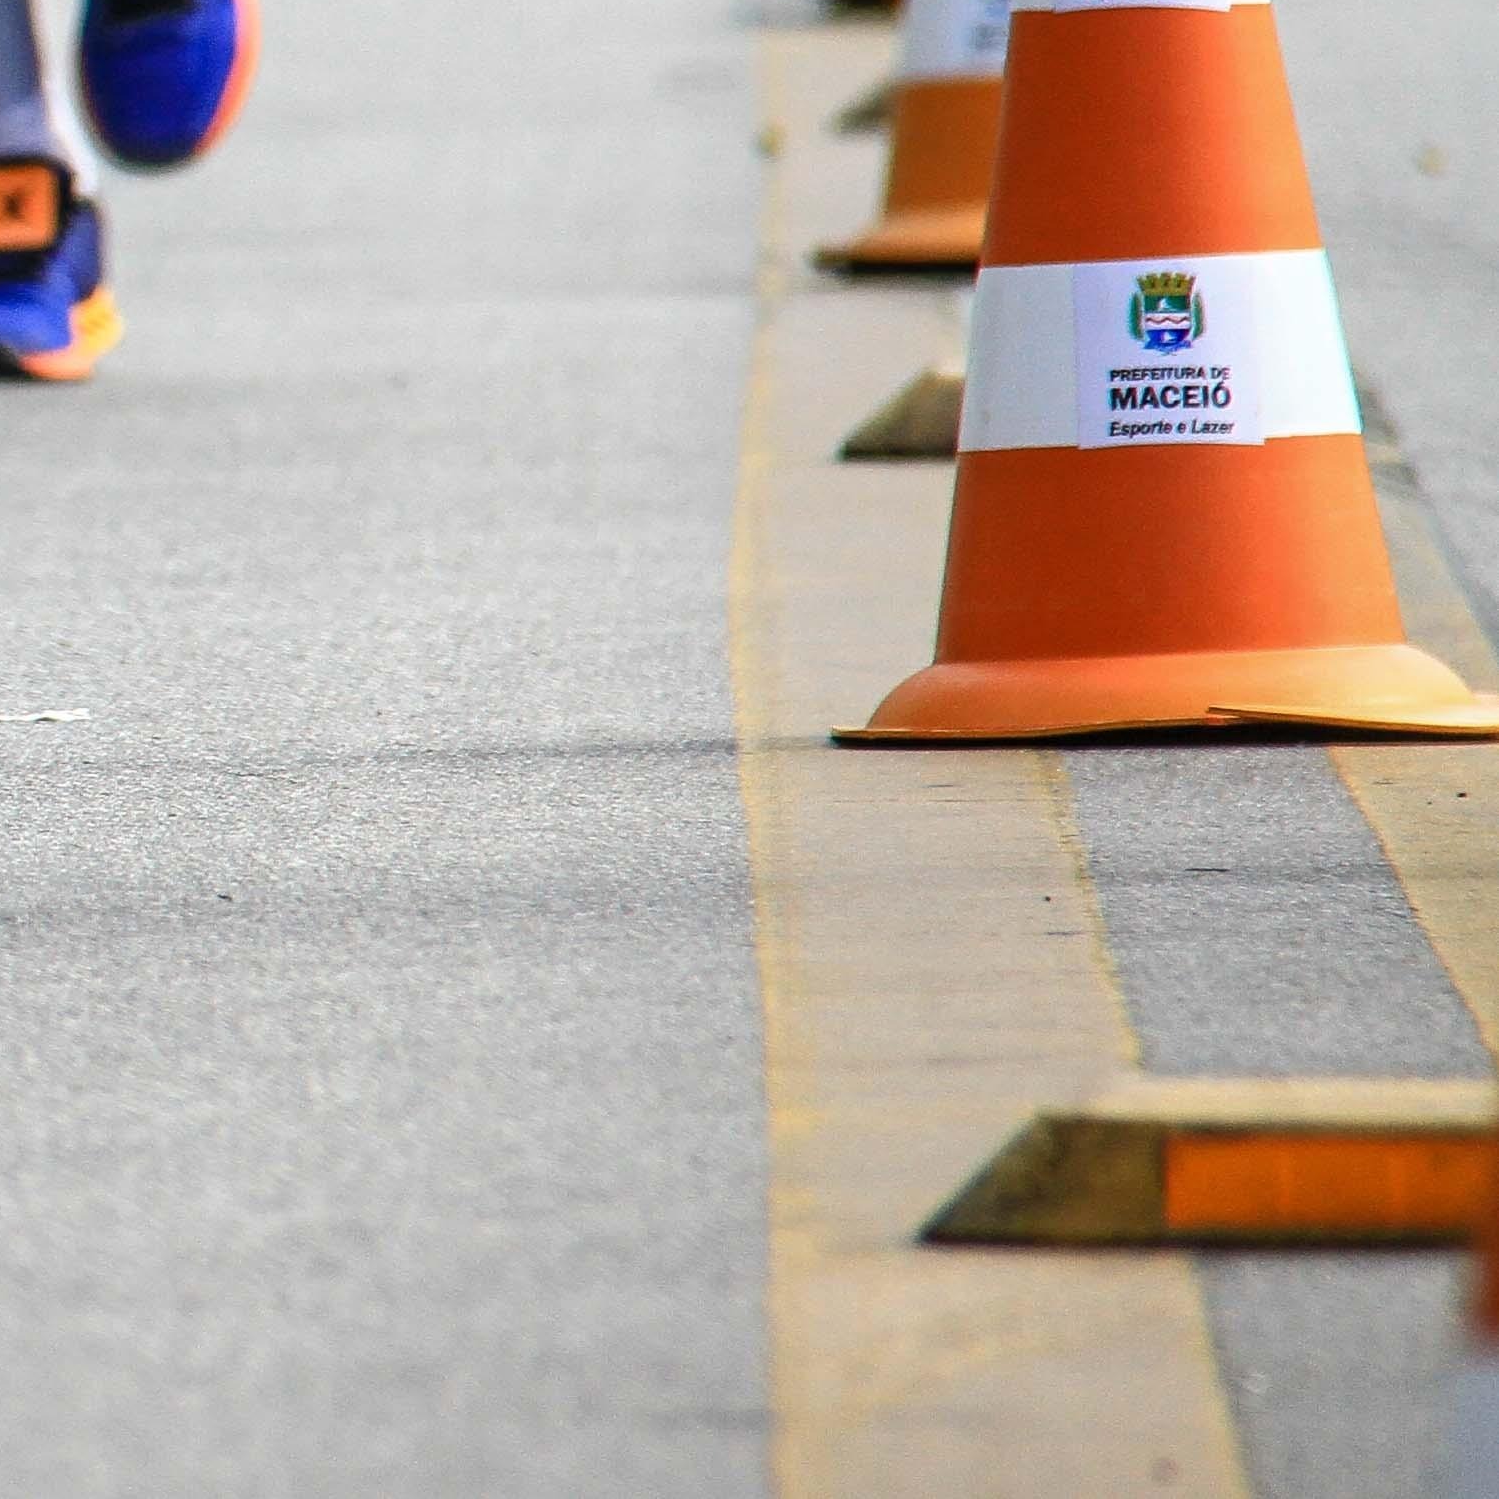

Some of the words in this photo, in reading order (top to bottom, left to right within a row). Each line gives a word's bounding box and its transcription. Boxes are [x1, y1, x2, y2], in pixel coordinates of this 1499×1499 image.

[1110, 366, 1205, 381] PREFEITURA
[1209, 366, 1232, 380] DE
[1110, 381, 1232, 411] MACEIÓ
[1109, 420, 1173, 439] Esporte
[1176, 423, 1187, 434] e
[1190, 419, 1235, 434] Lazer
